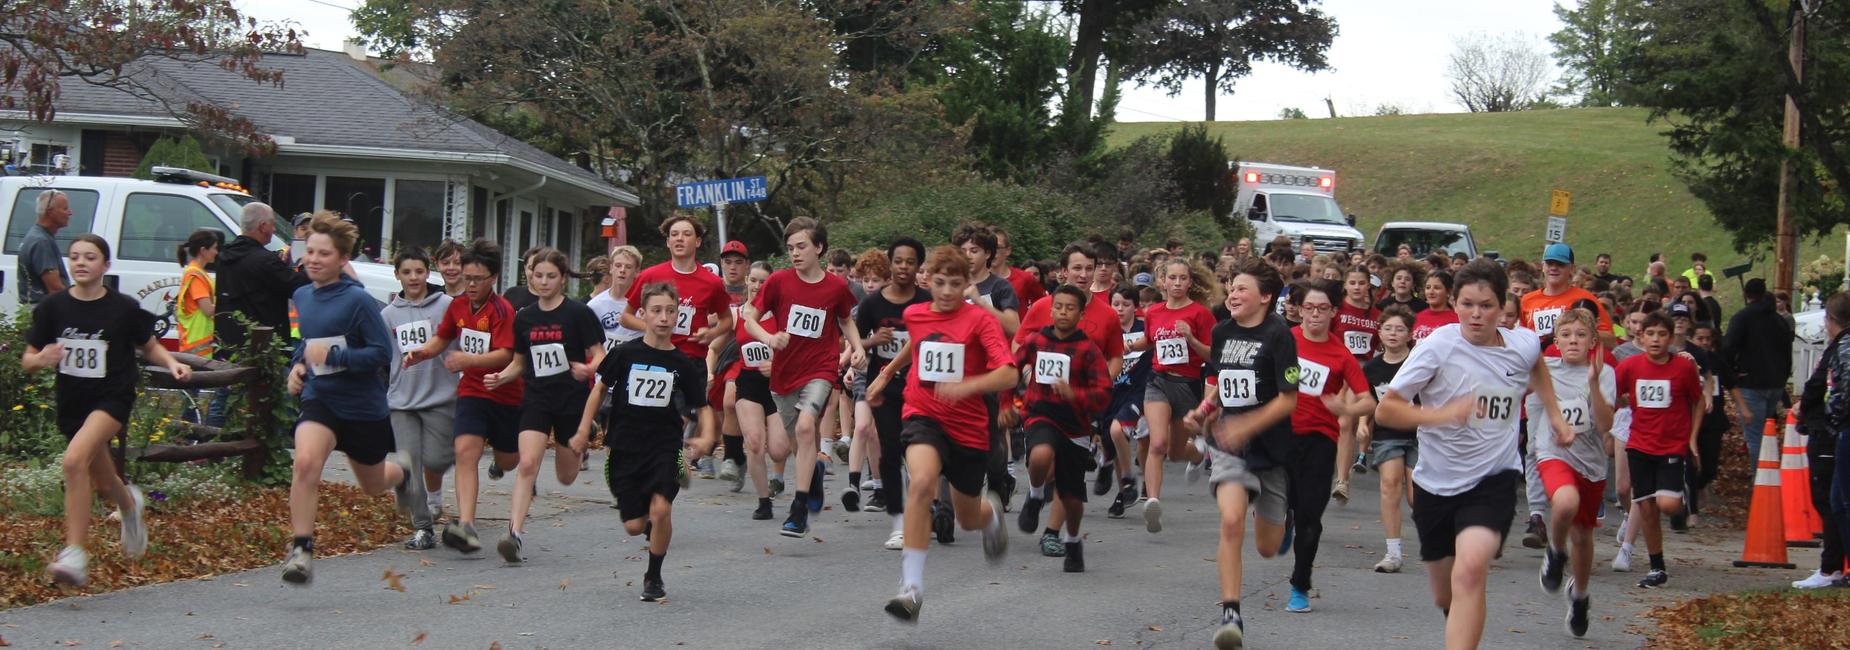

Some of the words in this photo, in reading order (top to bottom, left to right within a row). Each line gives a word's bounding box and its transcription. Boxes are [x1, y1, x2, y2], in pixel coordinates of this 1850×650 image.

[676, 180, 747, 206] FRANKLIN
[751, 178, 760, 191] ST
[1549, 229, 1561, 241] 15
[793, 311, 820, 332] 760
[401, 327, 427, 346] 949
[464, 335, 484, 355] 933
[1349, 335, 1367, 350] 905
[64, 346, 98, 369] 788
[536, 351, 562, 369] 741
[747, 345, 769, 362] 906
[1161, 343, 1184, 359] 733
[925, 350, 956, 374] 911
[1039, 359, 1064, 378] 923
[1299, 367, 1321, 389] 28
[634, 378, 667, 399] 722
[1223, 378, 1250, 399] 913
[1640, 385, 1664, 402] 829
[1475, 395, 1512, 420] 963
[1562, 407, 1584, 426] 22
